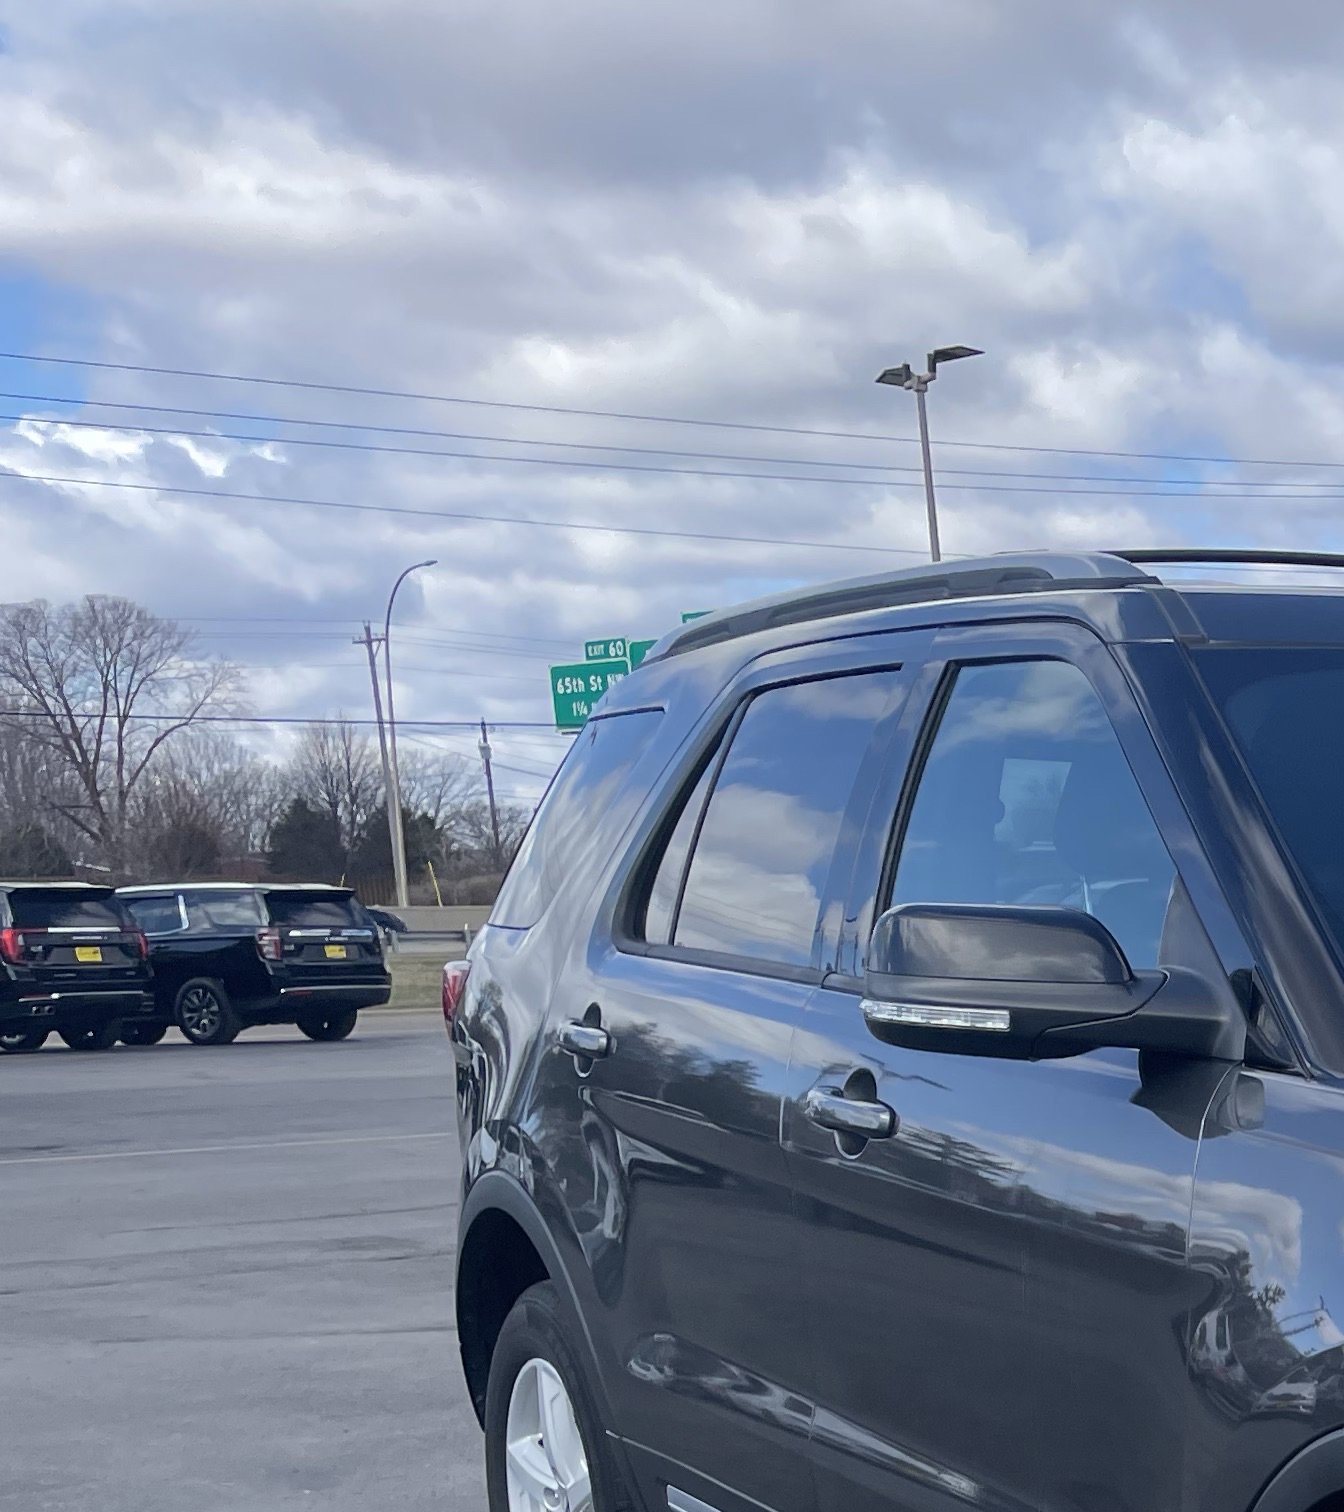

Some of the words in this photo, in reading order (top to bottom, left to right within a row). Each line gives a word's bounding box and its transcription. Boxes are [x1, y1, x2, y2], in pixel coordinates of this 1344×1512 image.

[608, 641, 625, 657] 60
[556, 676, 585, 694] 65th
[589, 675, 603, 692] St
